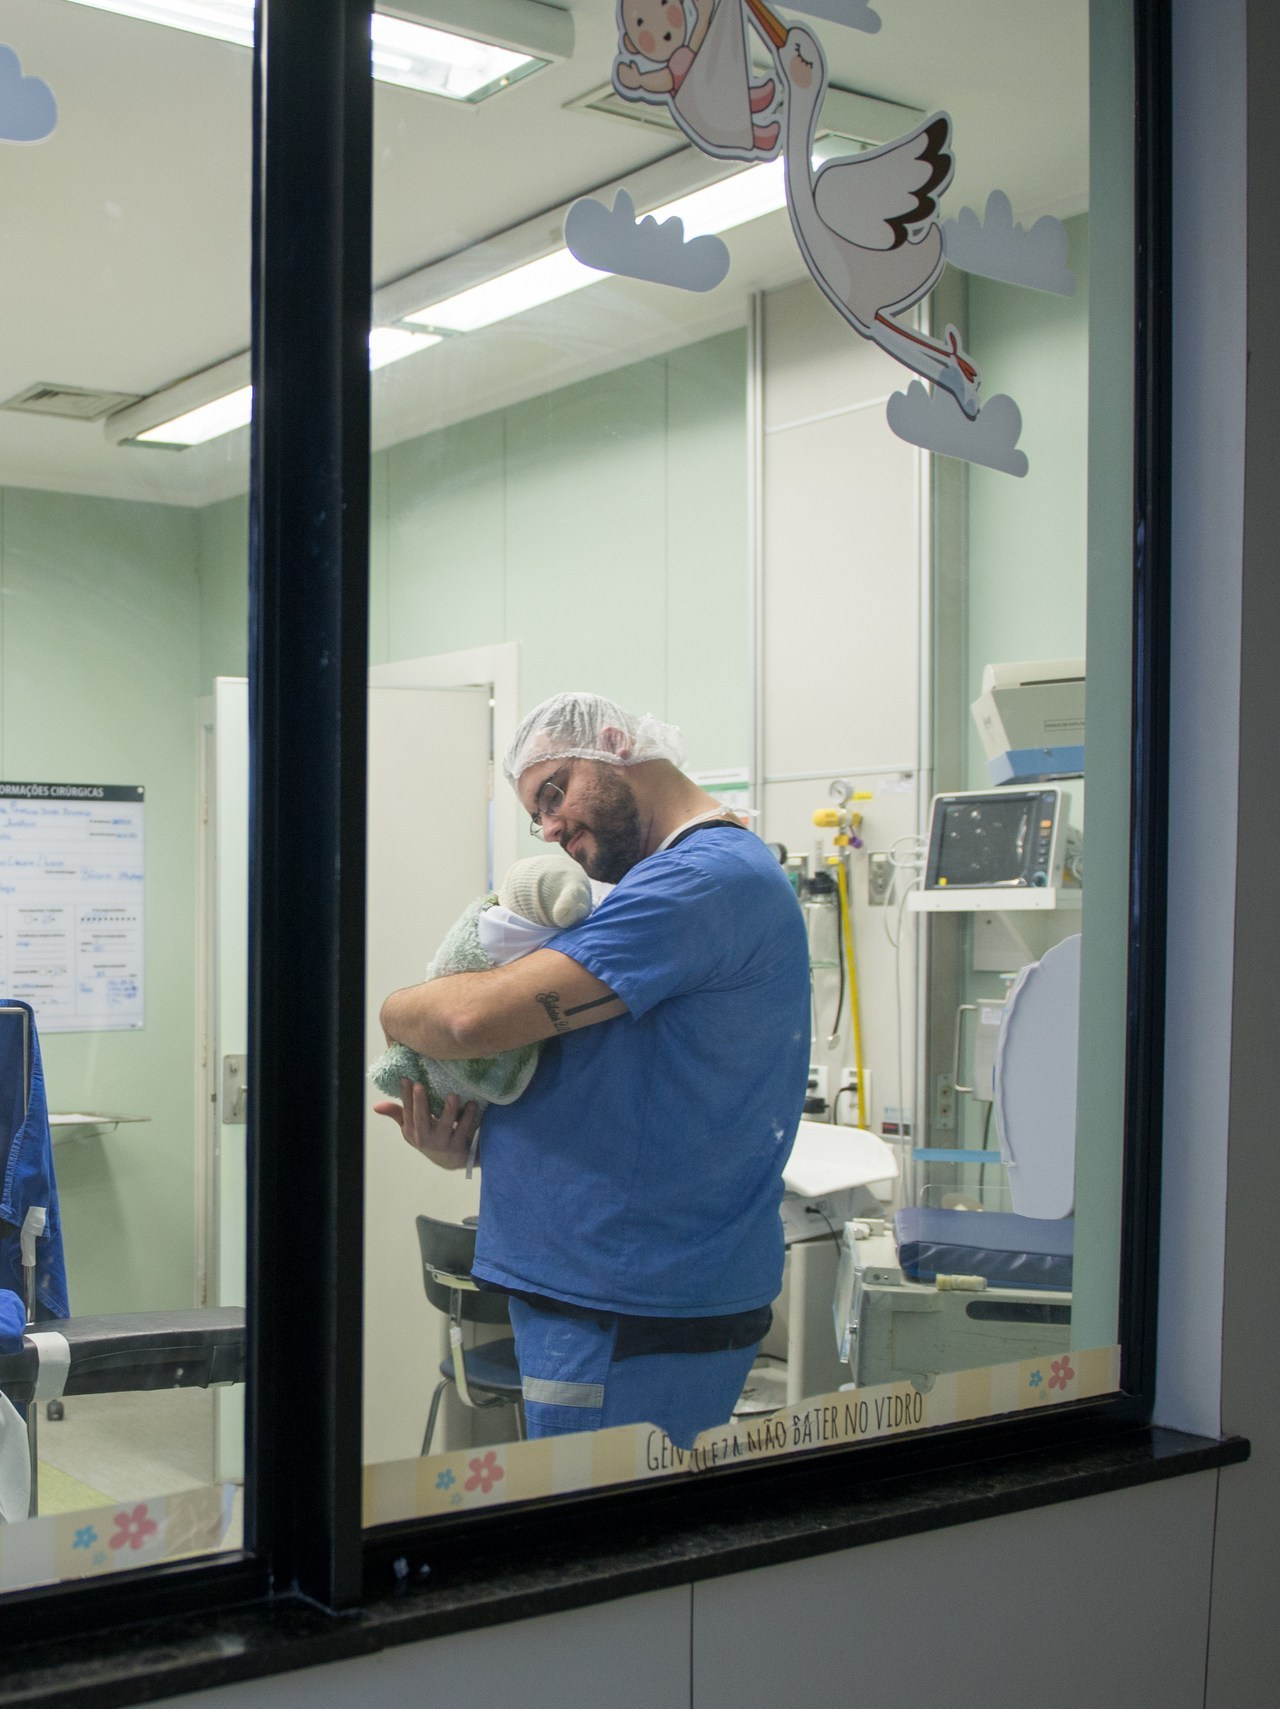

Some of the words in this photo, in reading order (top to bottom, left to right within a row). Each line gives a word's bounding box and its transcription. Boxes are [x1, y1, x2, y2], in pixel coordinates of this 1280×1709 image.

[50, 785, 104, 797] CIRÚRGICAS
[747, 1418, 787, 1452] NÃO
[793, 1406, 838, 1445] BATER
[845, 1401, 868, 1435] NO
[875, 1392, 922, 1430] VIDRO
